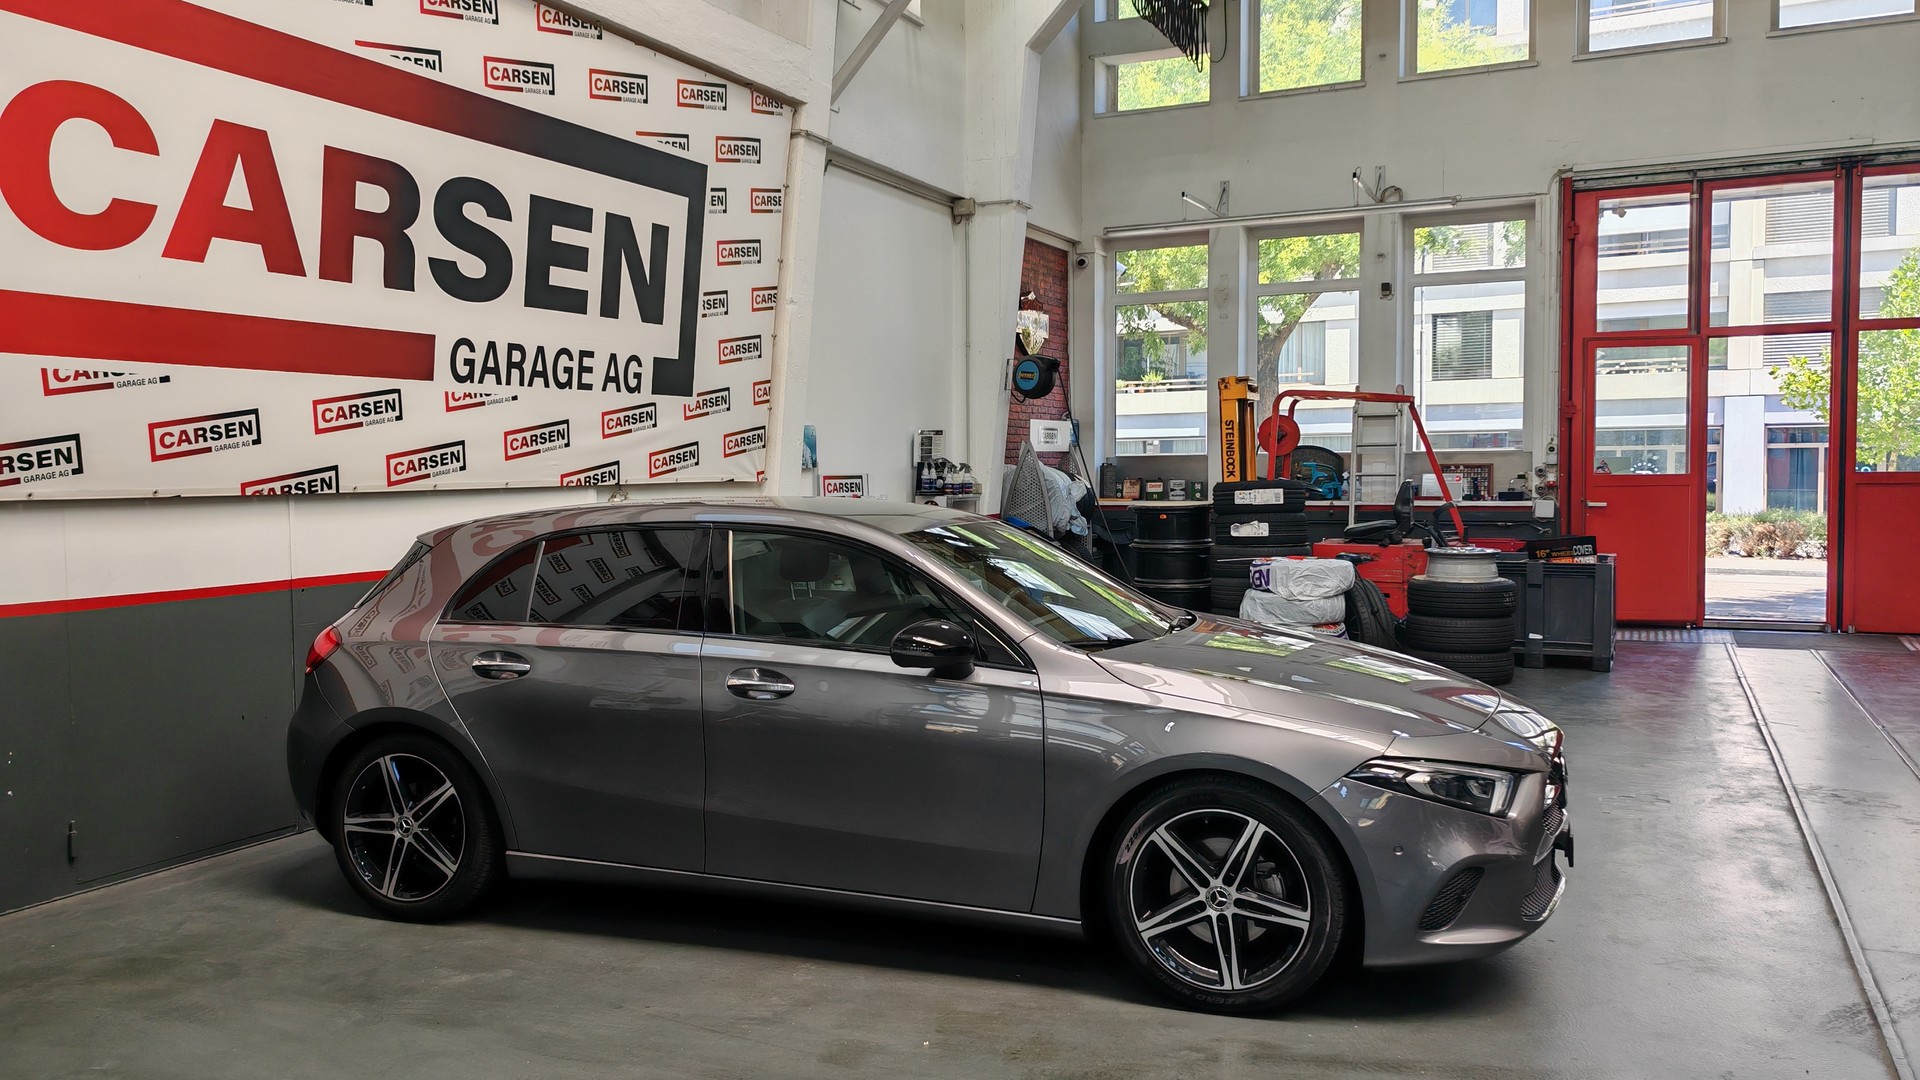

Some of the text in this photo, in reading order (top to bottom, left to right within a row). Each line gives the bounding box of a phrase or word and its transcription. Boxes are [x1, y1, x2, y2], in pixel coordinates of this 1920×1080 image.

[465, 15, 484, 23] GARAGE
[490, 66, 550, 86] CARSEN
[594, 78, 644, 95] CARSEN
[681, 88, 724, 103] CARSEN
[720, 144, 758, 156] CARSEN
[0, 80, 669, 325] CARSEN
[721, 246, 758, 258] CARSEN
[722, 341, 759, 357] CARSEN
[449, 337, 643, 394] GARAGE AG
[116, 378, 146, 389] GARAGE
[321, 398, 396, 423] CARSEN
[364, 418, 385, 427] GARAGE
[606, 410, 653, 430] CARSEN
[158, 420, 253, 449] CARSEN
[510, 428, 566, 451] CARSEN
[727, 432, 763, 450] CARSEN
[214, 441, 240, 452] GARAGE
[542, 445, 558, 453] GARAGE
[1225, 420, 1236, 478] STEINBOCK
[393, 450, 461, 476] CARSEN
[653, 449, 696, 469] CARSEN
[23, 470, 70, 484] GARAGE AG
[432, 469, 451, 478] GARAGE
[826, 481, 861, 494] CARSEN
[1573, 545, 1593, 555] COVER
